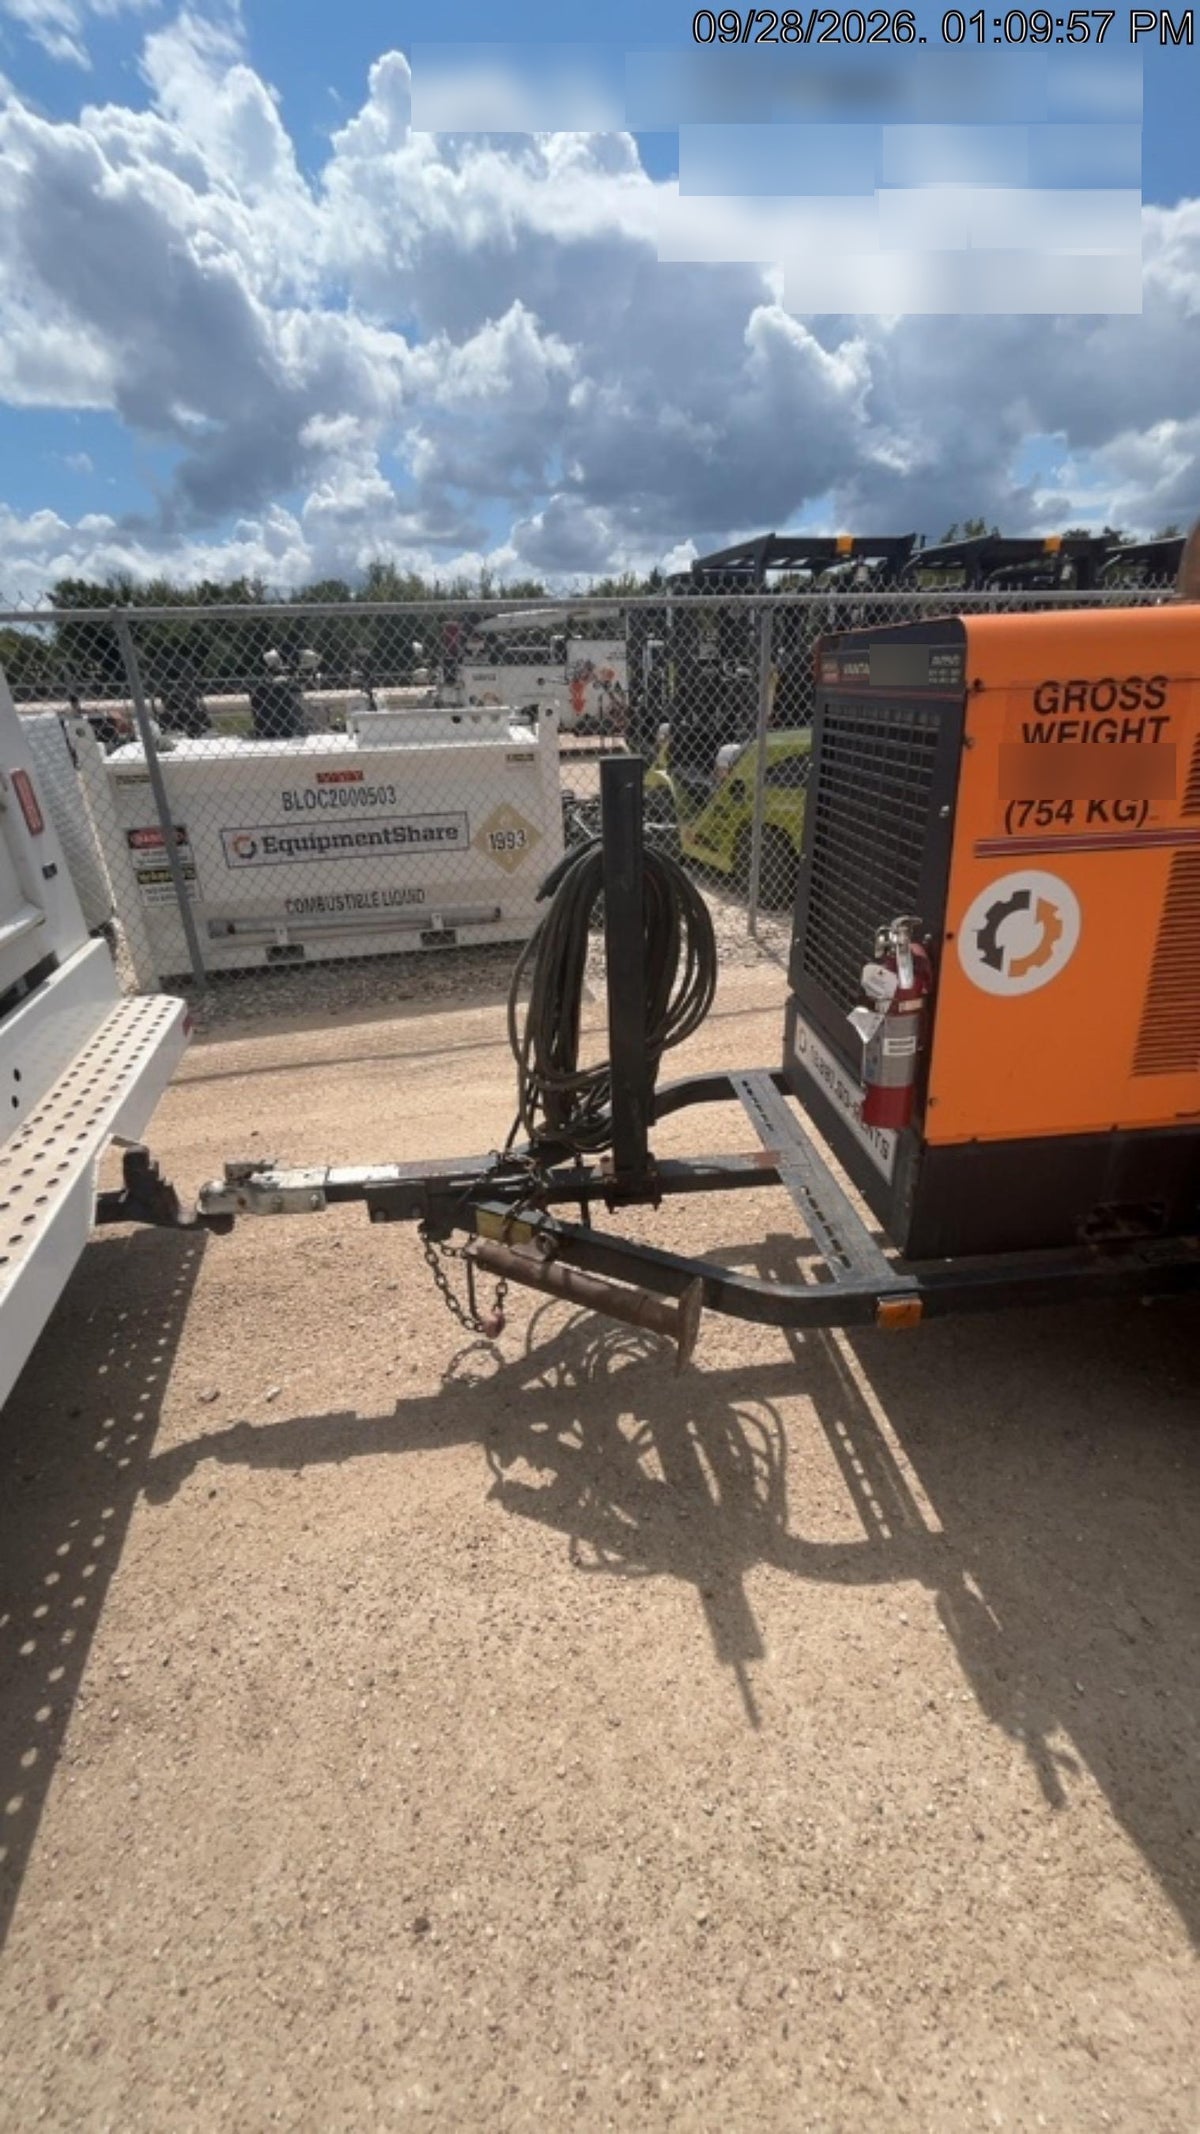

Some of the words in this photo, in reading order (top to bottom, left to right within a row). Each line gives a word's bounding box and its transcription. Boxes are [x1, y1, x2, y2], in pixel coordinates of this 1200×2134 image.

[1033, 675, 1168, 716] GROSS
[1022, 715, 1170, 744] WEIGHT
[1004, 799, 1074, 835] (754
[1086, 799, 1149, 828] KG)
[262, 825, 459, 857] EquipmentShare
[489, 829, 526, 851] 1993
[285, 890, 380, 914] COMBUSTIBLE
[382, 888, 426, 907] LIQUID
